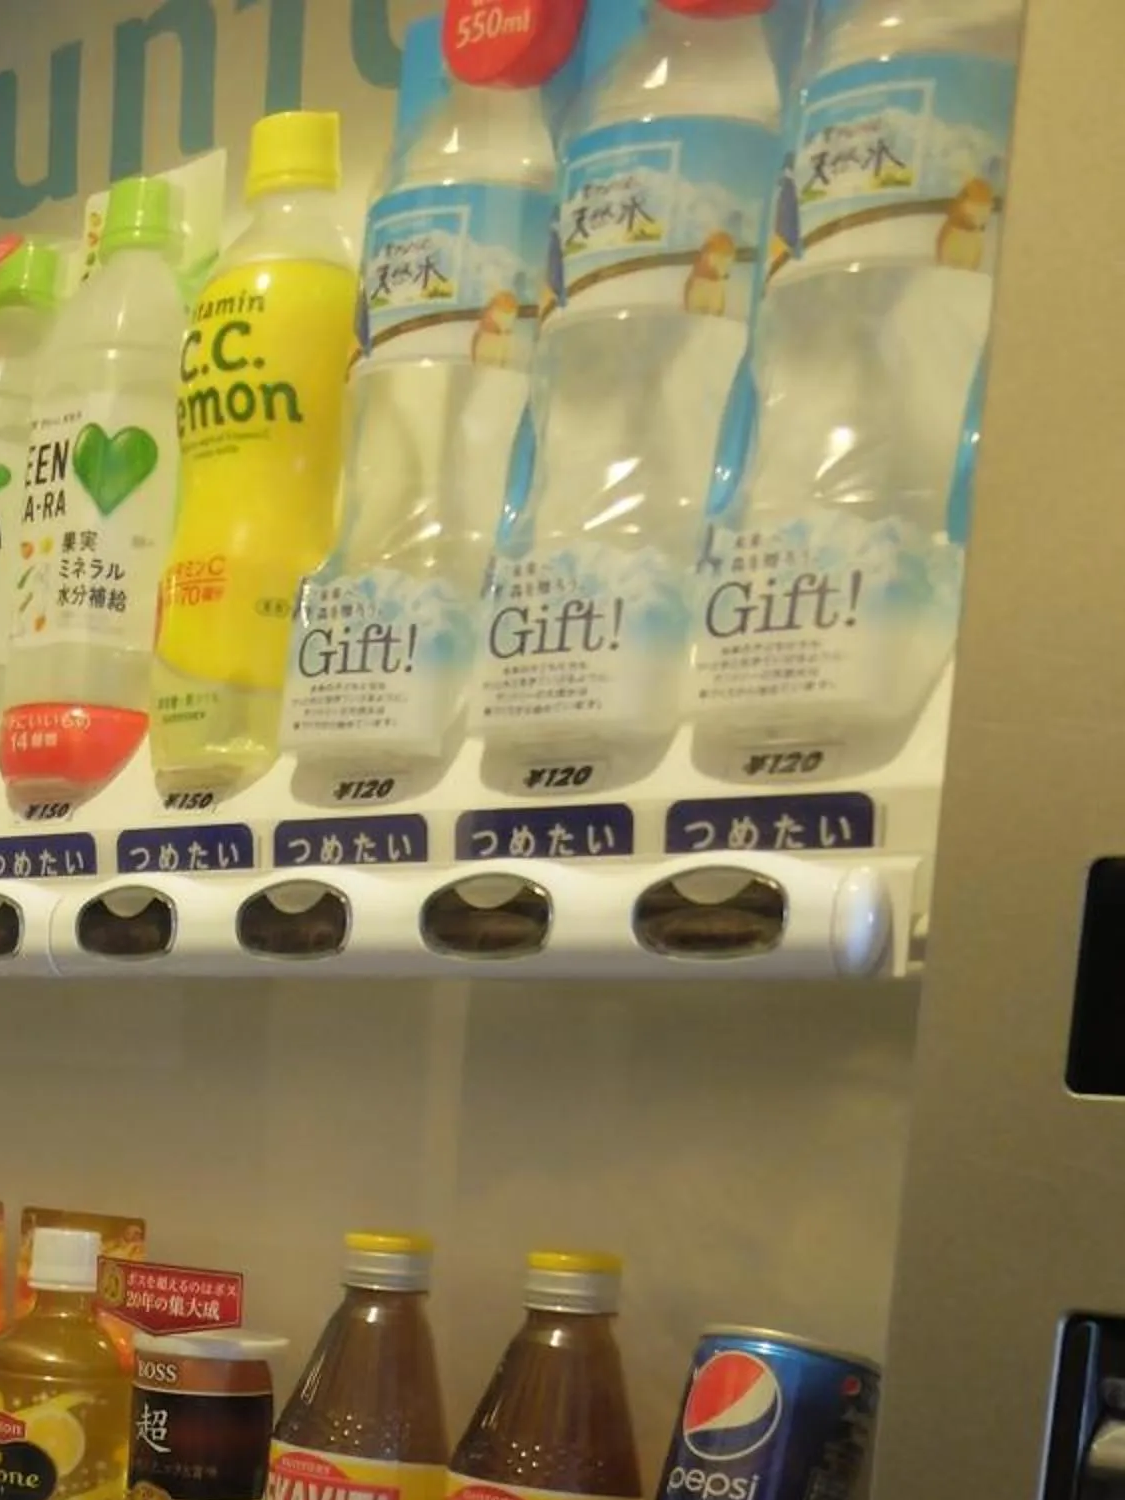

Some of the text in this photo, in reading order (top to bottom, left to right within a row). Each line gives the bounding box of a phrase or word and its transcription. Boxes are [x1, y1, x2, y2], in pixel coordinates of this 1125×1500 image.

[455, 9, 531, 51] 550ml
[62, 530, 99, 552] 果実
[57, 558, 125, 582] ミネラル
[56, 587, 128, 614] 水分補給
[705, 568, 863, 638] Gift!
[489, 596, 624, 659] Gift!
[298, 623, 417, 678] Gift!
[524, 764, 593, 788] ¥120
[743, 750, 824, 776] ¥120
[163, 792, 215, 810] ¥150
[334, 777, 395, 800] ¥120
[25, 803, 70, 819] ¥150
[472, 823, 615, 856] つめたい
[684, 814, 851, 850] つめたい
[129, 841, 240, 870] つめたい
[287, 833, 412, 864] つめたい
[126, 1271, 237, 1298] ボスを超えるのはボス
[138, 1359, 178, 1382] BOSS
[135, 1400, 172, 1454] 超
